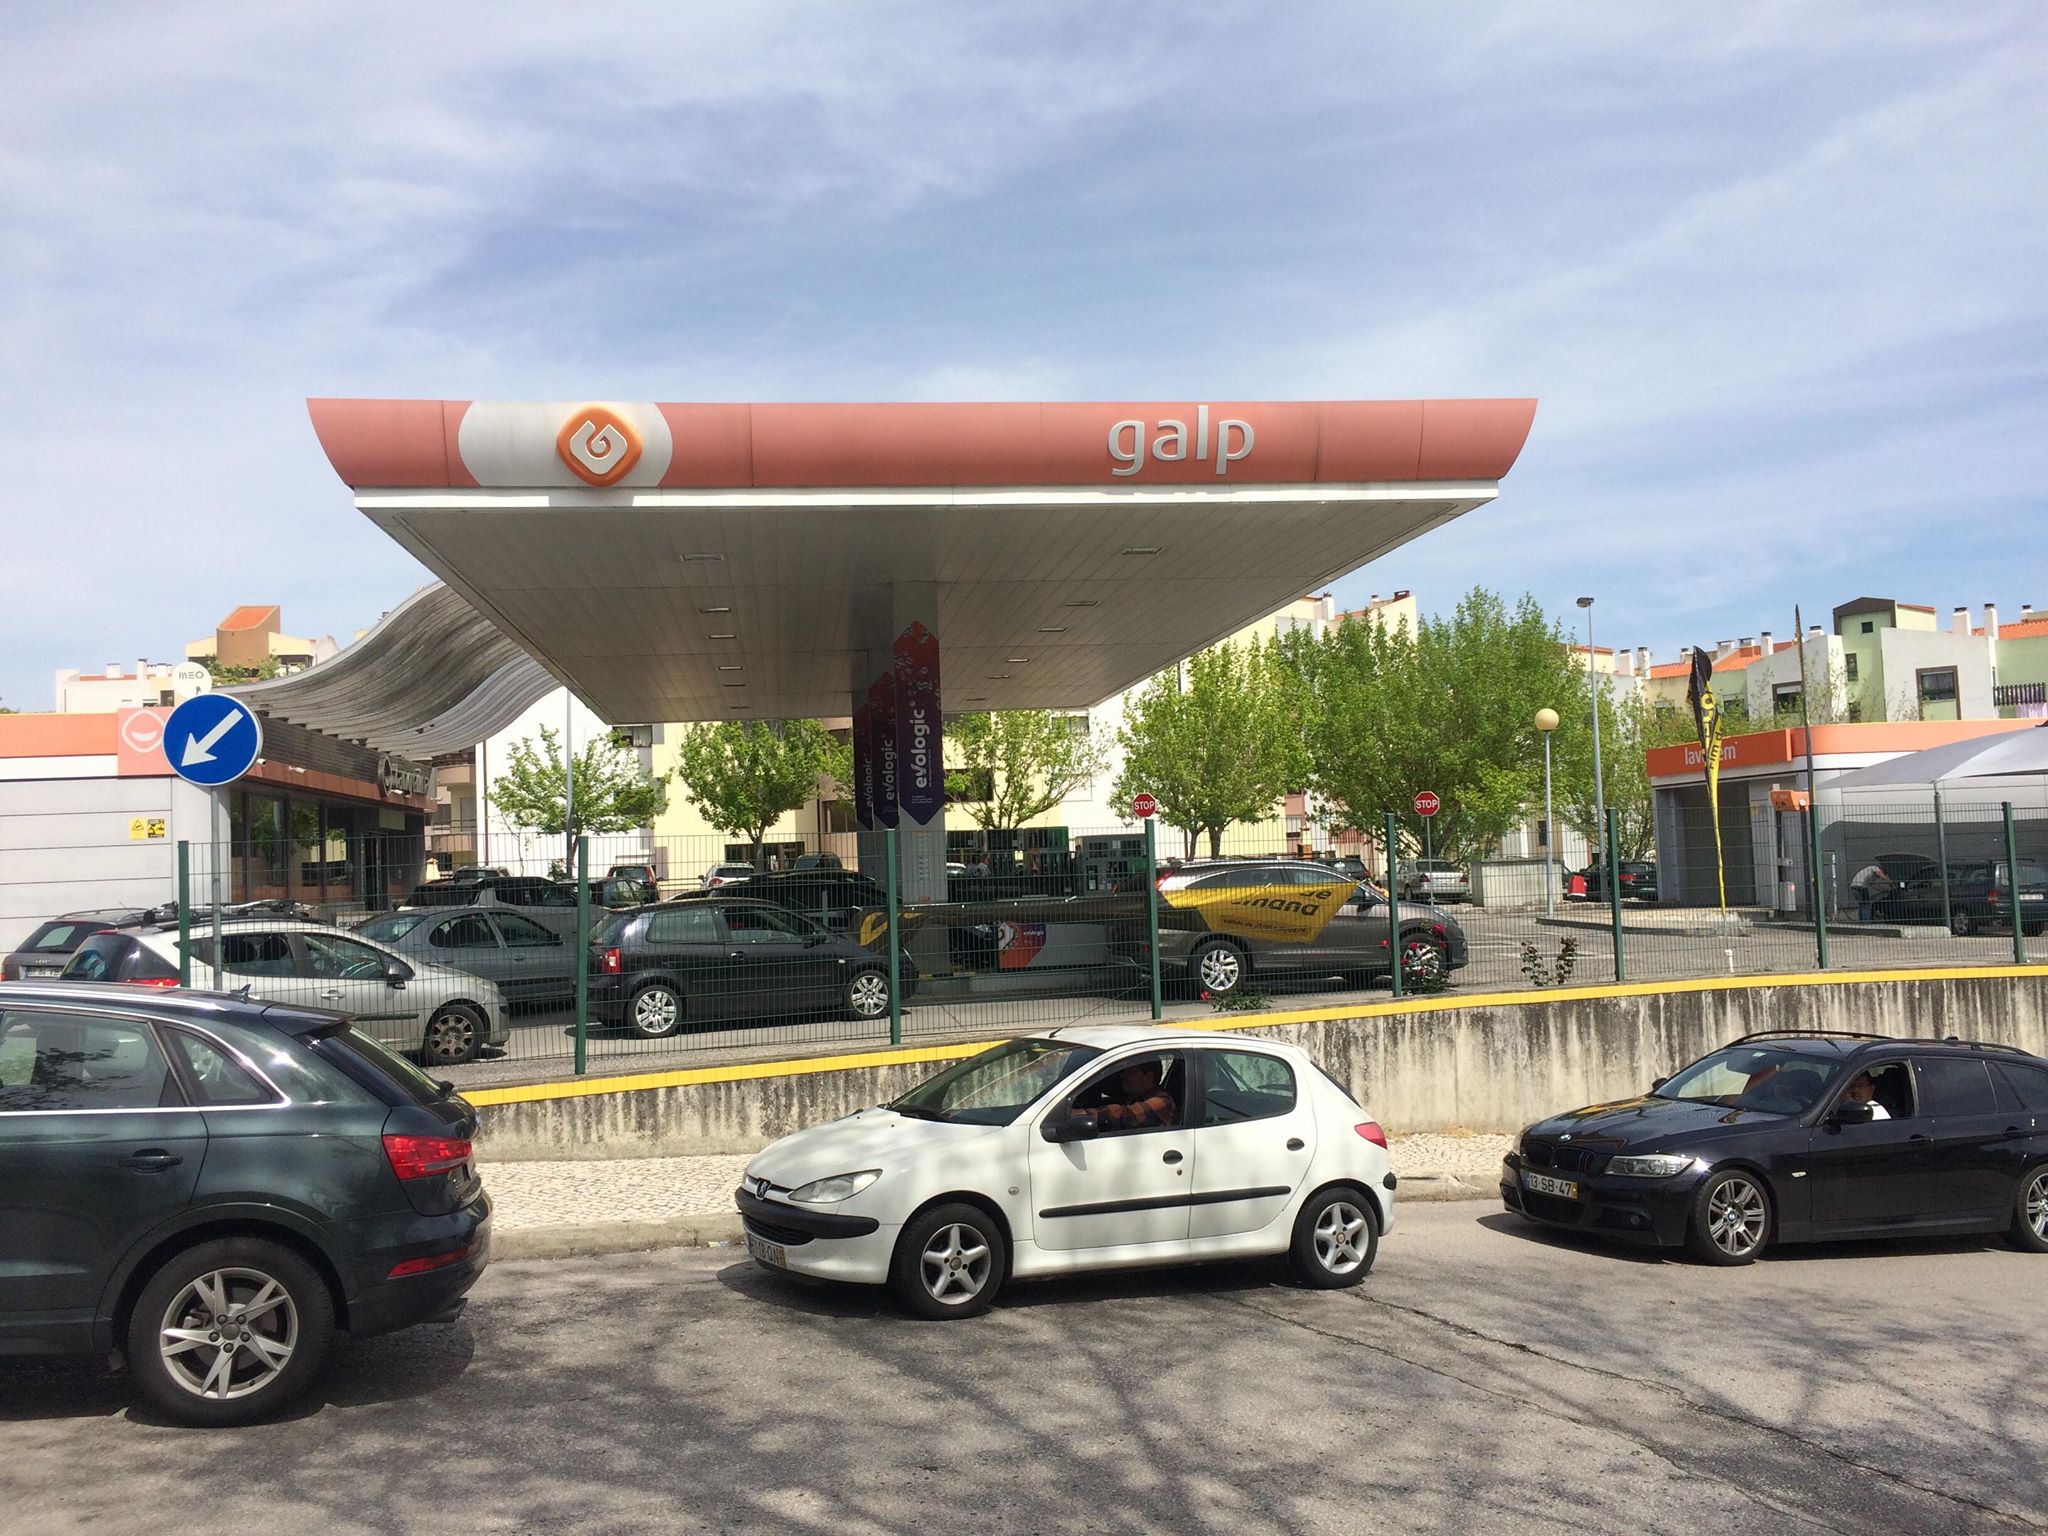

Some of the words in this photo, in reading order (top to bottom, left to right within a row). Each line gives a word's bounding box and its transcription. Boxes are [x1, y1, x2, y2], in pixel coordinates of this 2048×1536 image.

[1108, 405, 1255, 477] galp
[178, 671, 204, 680] MEO
[911, 708, 930, 788] evologic
[882, 739, 897, 801] evologic
[1134, 801, 1155, 810] STOP
[1415, 799, 1437, 809] STOP
